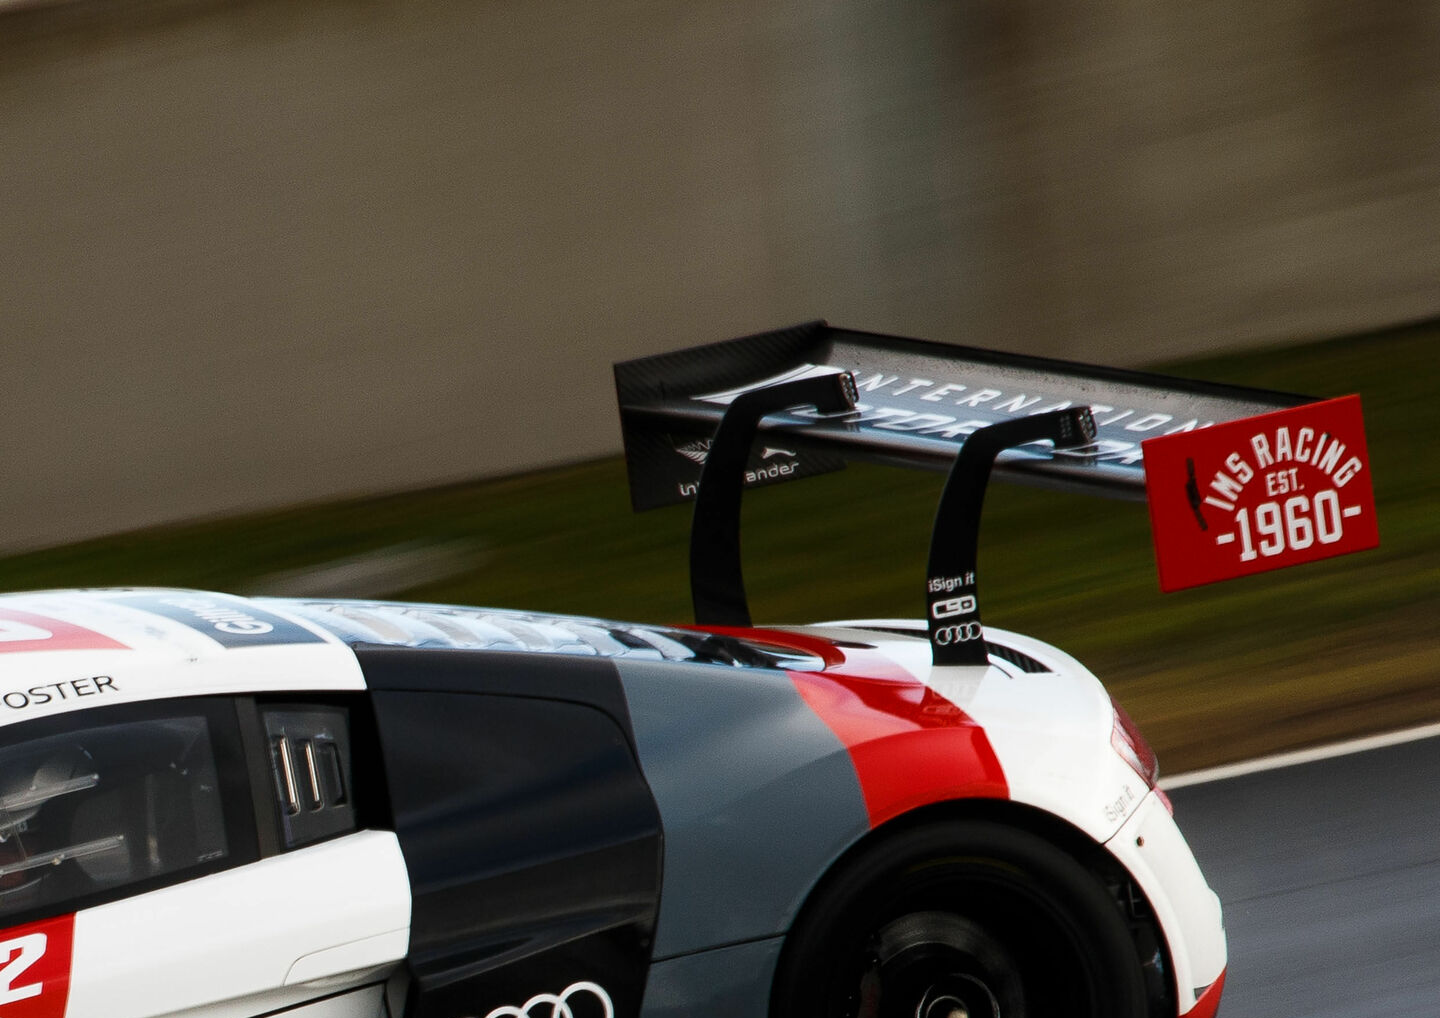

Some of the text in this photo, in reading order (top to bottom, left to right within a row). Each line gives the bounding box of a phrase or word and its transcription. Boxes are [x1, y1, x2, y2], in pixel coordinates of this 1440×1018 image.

[1203, 426, 1363, 512] IMS RACING
[1265, 467, 1306, 498] EST.
